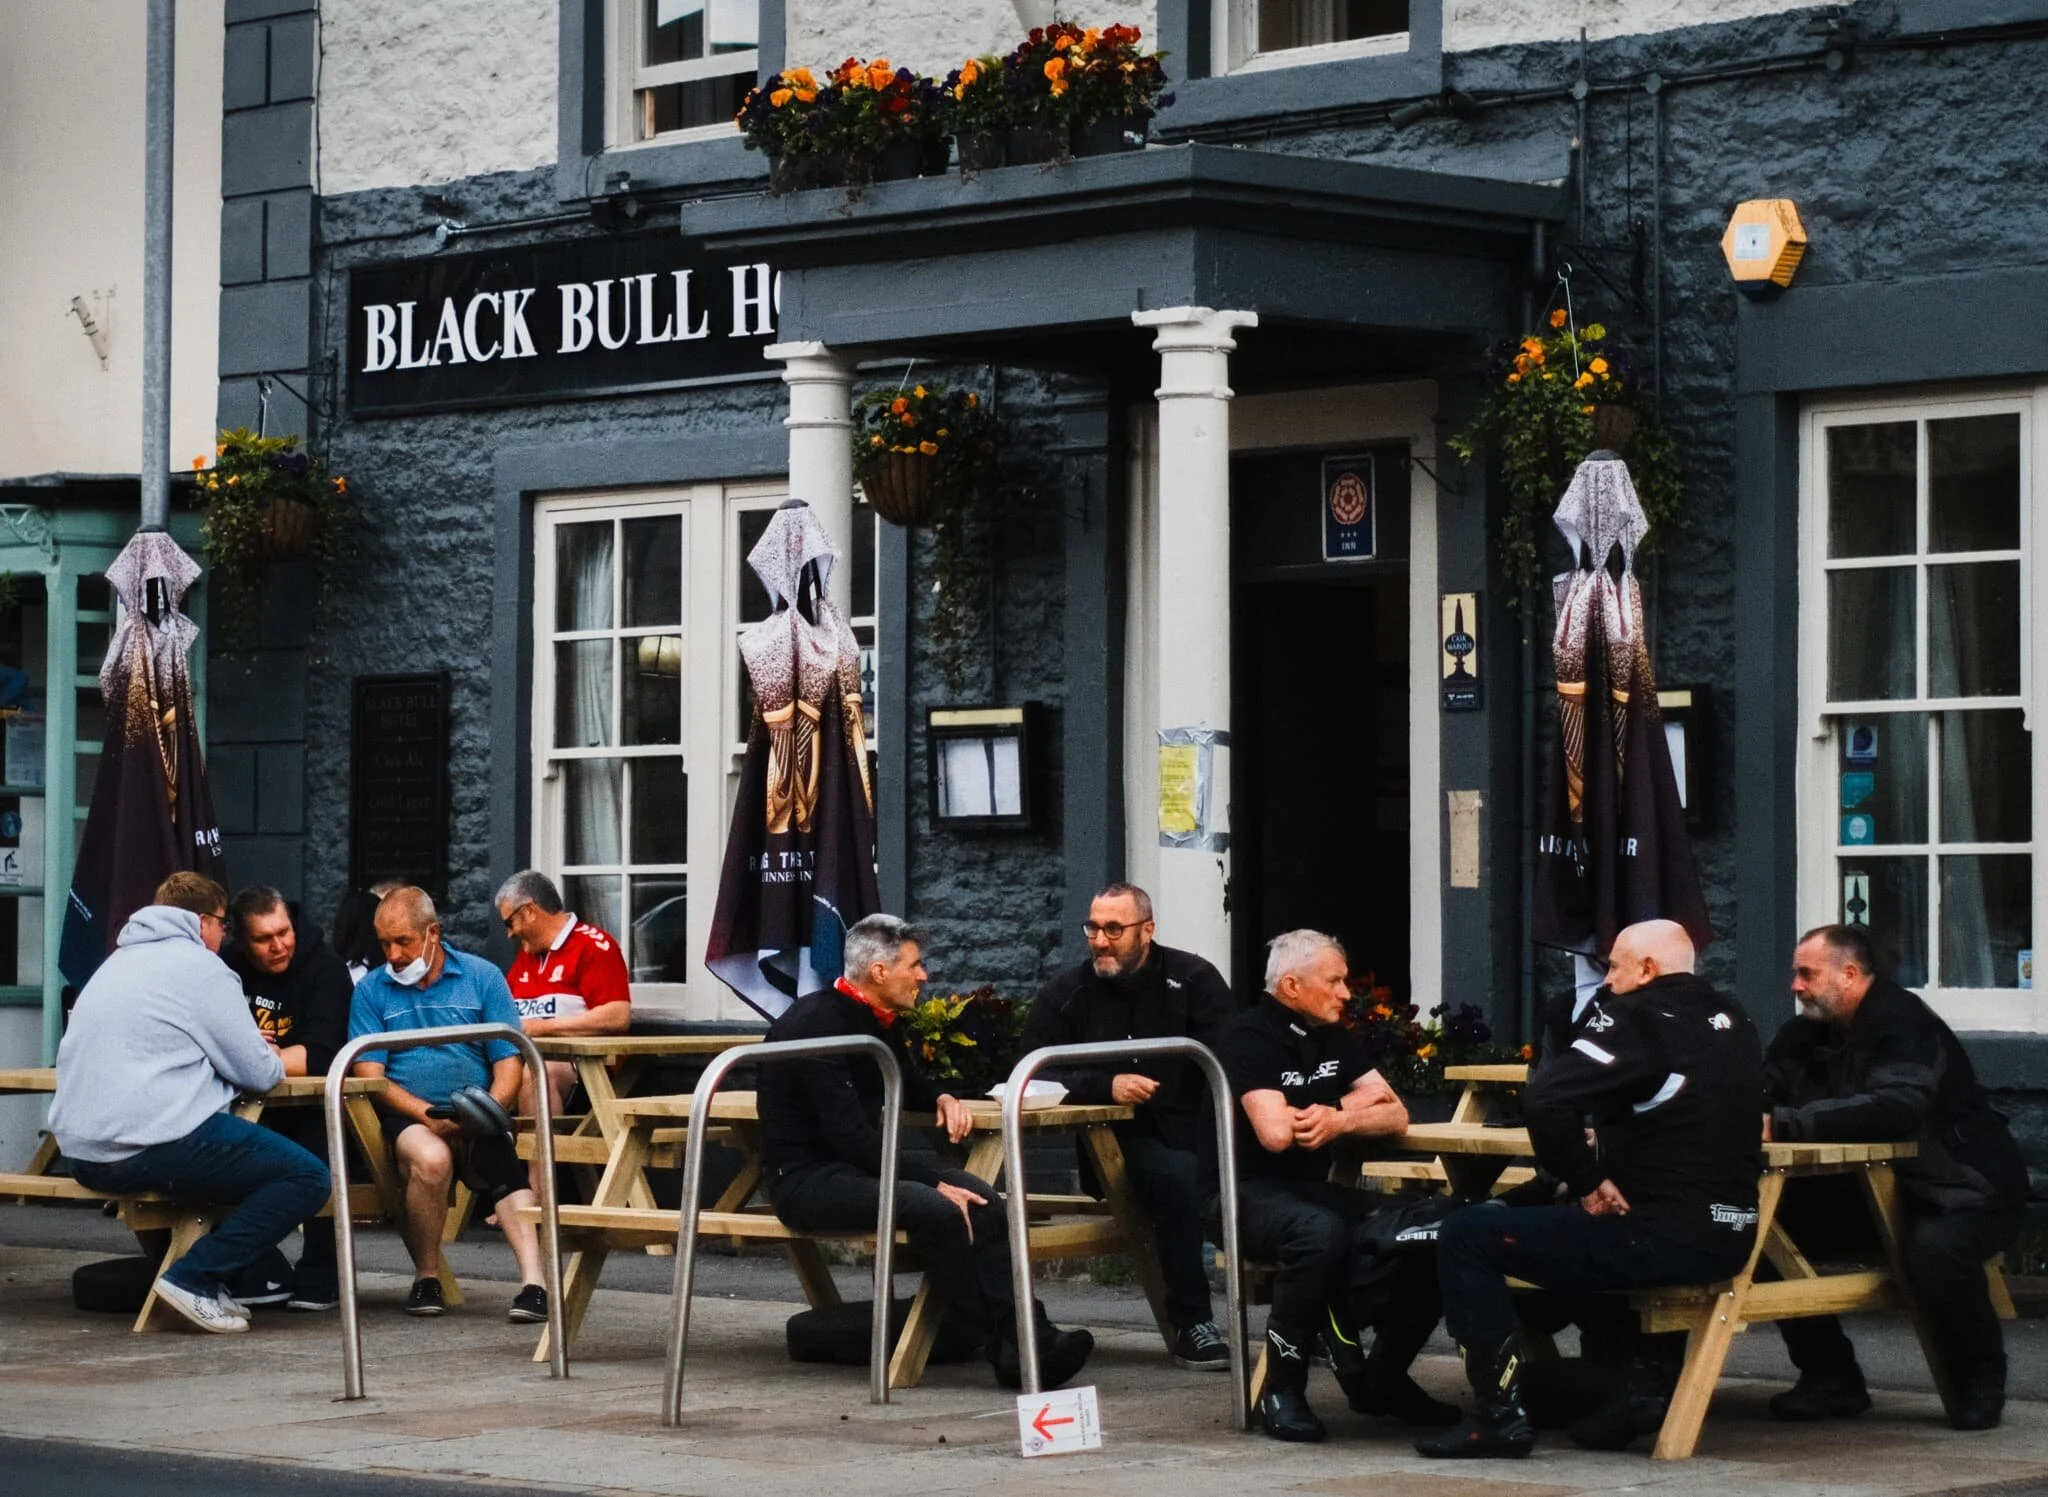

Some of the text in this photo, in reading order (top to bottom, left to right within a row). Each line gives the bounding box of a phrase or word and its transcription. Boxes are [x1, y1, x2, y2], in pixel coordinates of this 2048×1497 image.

[362, 263, 780, 373] BLACK BULL H
